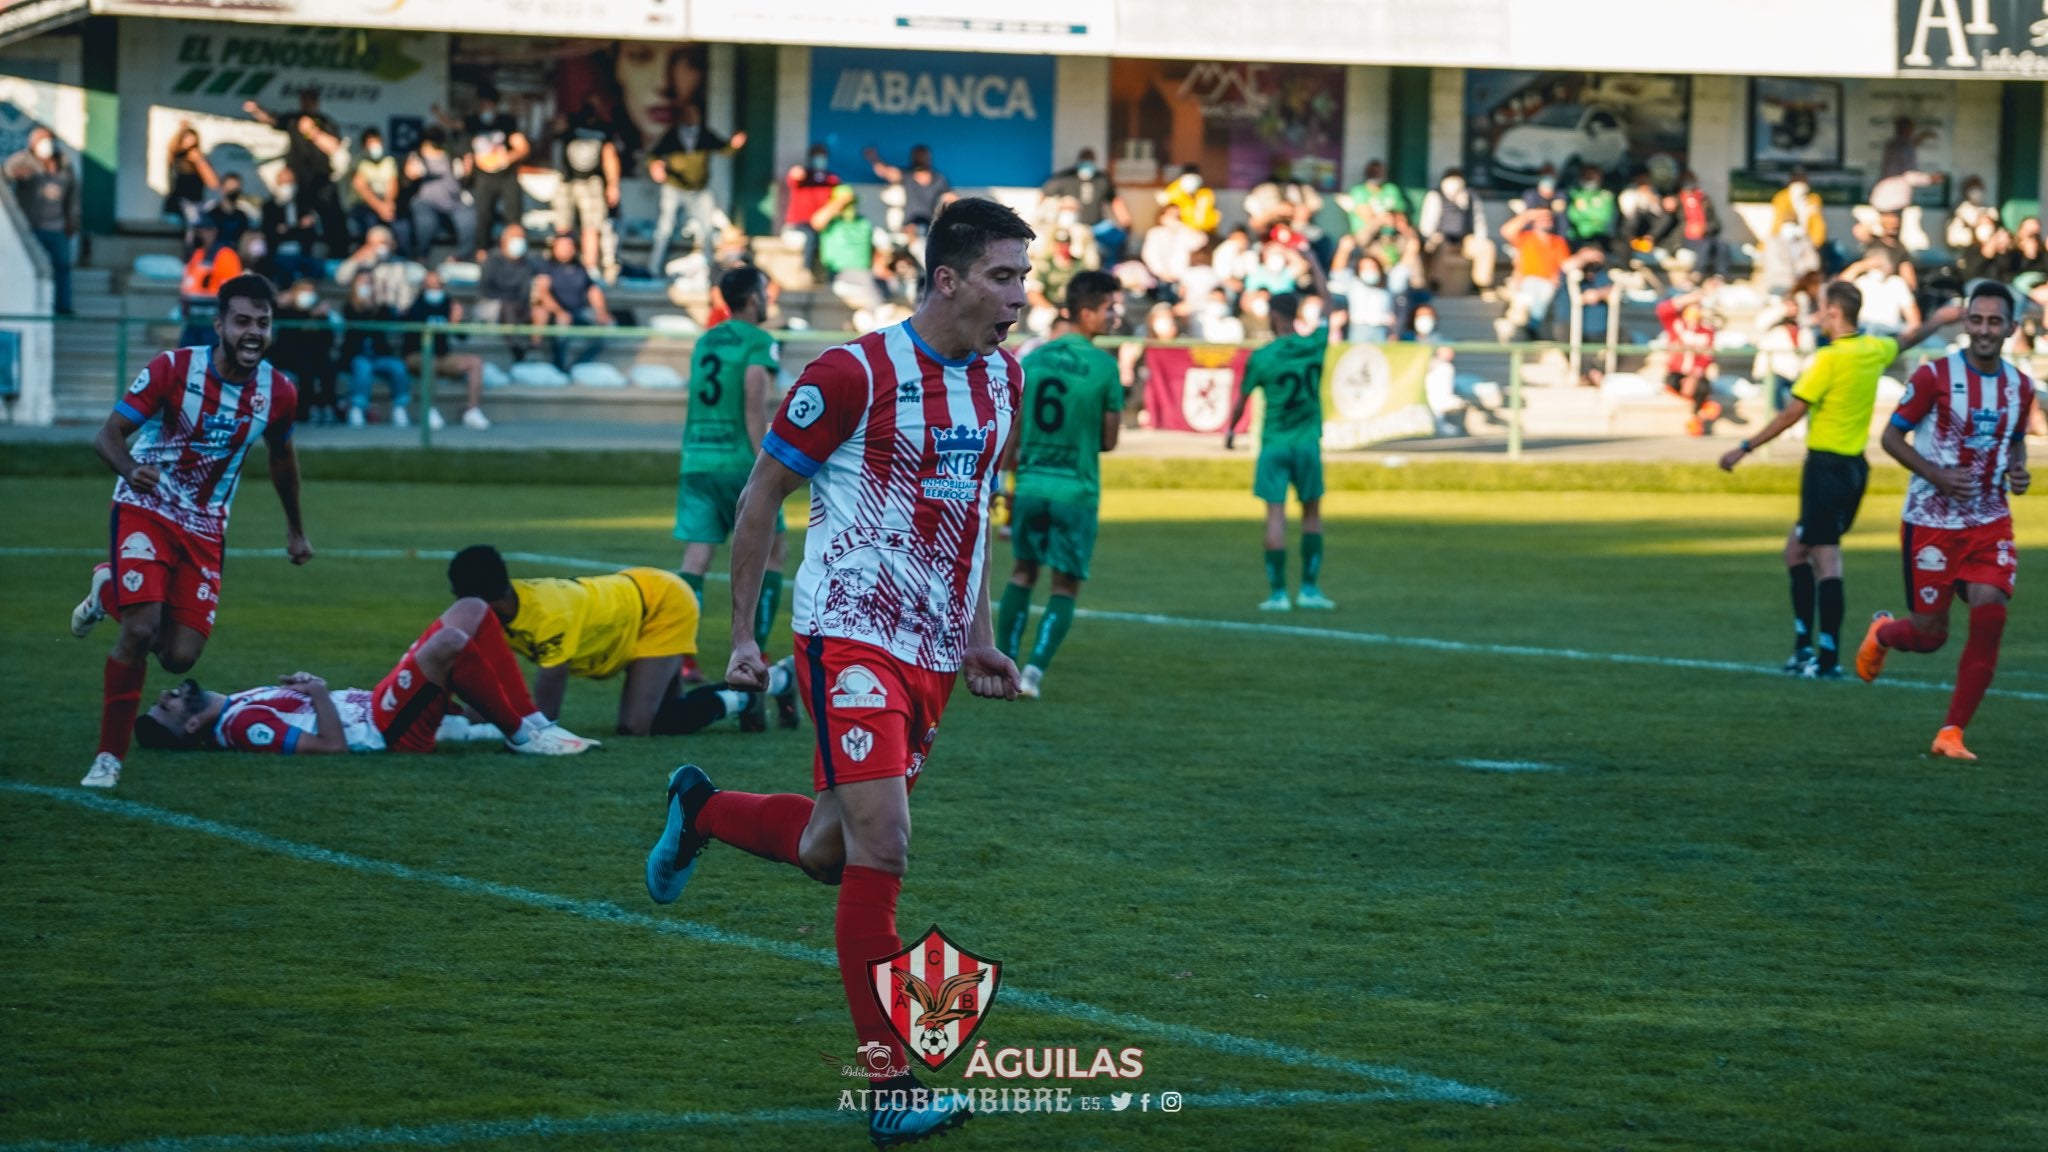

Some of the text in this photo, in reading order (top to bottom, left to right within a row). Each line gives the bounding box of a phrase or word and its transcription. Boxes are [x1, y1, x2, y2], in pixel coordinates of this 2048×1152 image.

[177, 35, 213, 63] EL
[1904, 0, 1998, 67] A
[852, 70, 1038, 121] ABANCA
[698, 353, 723, 407] 3
[1034, 376, 1067, 433] 6
[1276, 362, 1323, 411] 20
[937, 452, 978, 476] NB
[925, 488, 975, 501] BERROCAL
